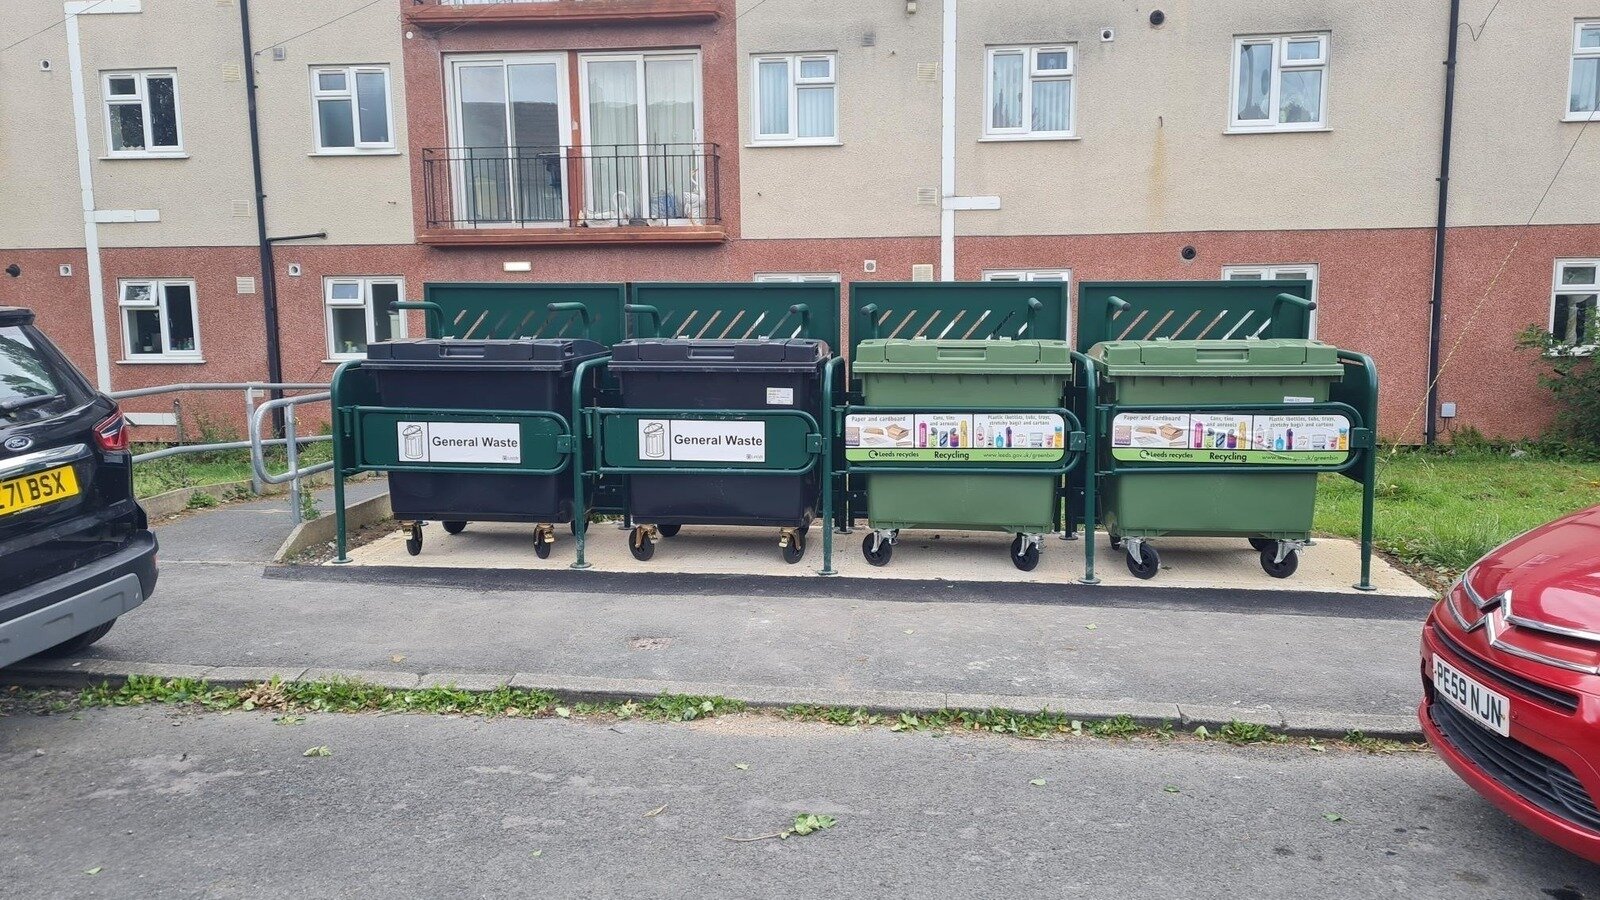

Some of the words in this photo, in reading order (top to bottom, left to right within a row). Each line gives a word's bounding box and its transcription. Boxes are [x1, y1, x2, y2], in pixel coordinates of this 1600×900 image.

[432, 436, 478, 448] General
[482, 437, 518, 448] Waste
[674, 434, 721, 446] General
[725, 435, 763, 446] Waste
[897, 451, 919, 459] recycles
[934, 451, 970, 460] Recycling
[1169, 451, 1193, 459] recycles
[1209, 452, 1247, 461] Recycling
[0, 482, 24, 509] 71
[26, 471, 66, 500] BSX
[1437, 661, 1467, 706] PE59
[1470, 684, 1502, 728] NJN
